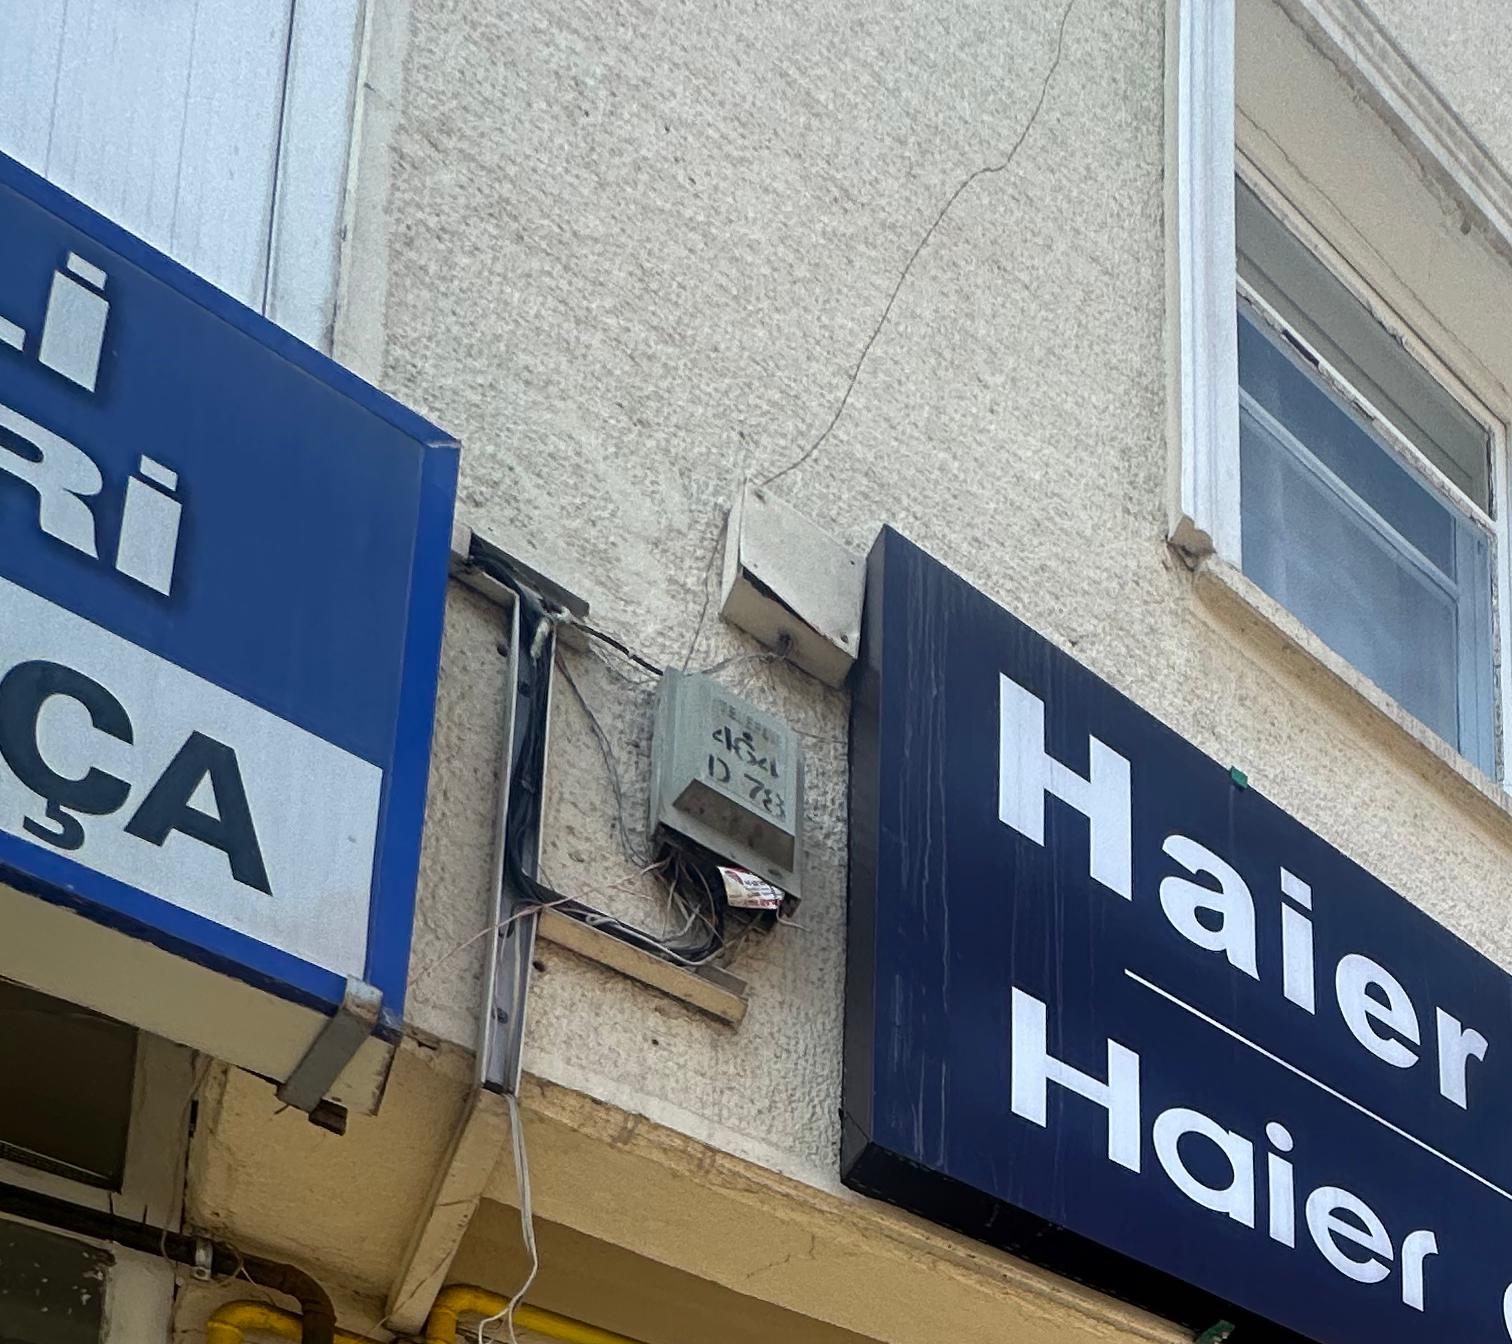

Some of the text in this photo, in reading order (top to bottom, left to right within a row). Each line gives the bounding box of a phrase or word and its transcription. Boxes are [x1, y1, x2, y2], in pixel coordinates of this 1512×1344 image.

[0, 659, 273, 898] ÇA
[999, 672, 1489, 1111] Haier
[1011, 986, 1440, 1313] Haier
